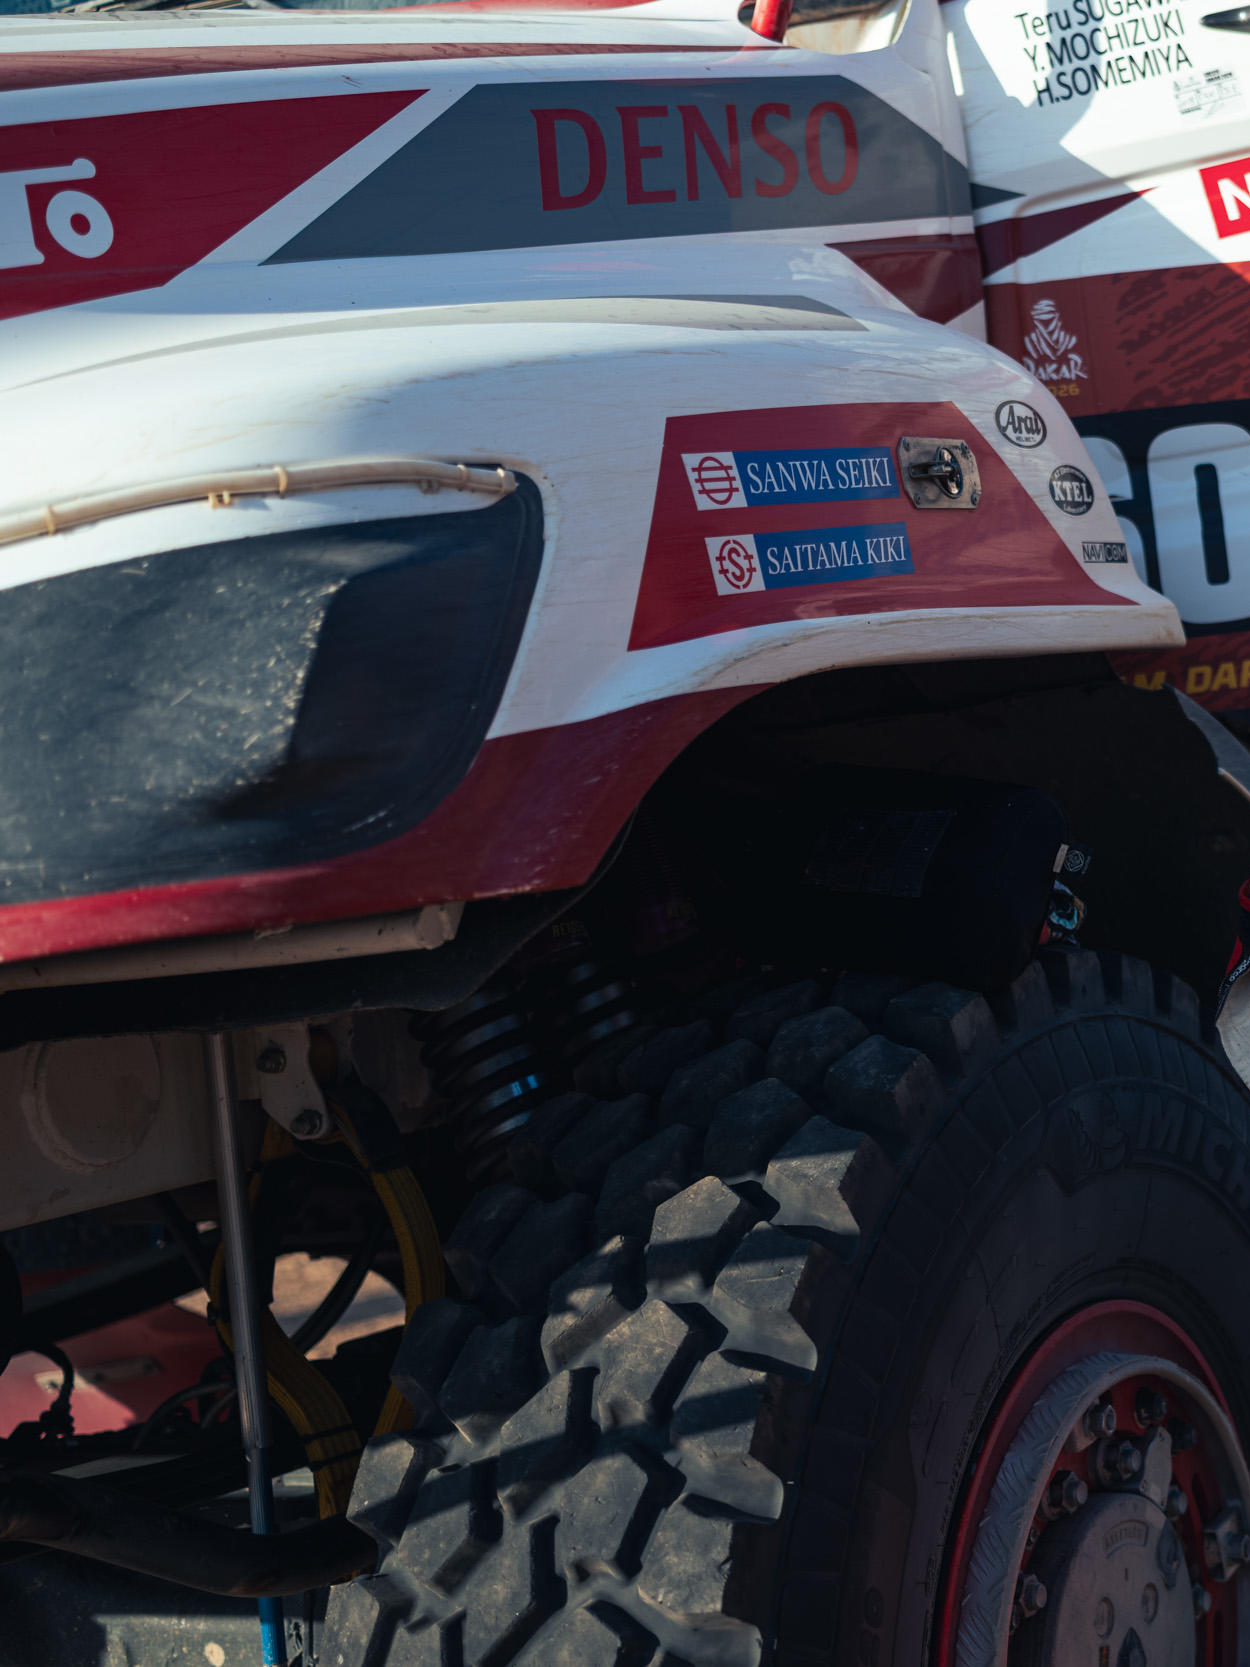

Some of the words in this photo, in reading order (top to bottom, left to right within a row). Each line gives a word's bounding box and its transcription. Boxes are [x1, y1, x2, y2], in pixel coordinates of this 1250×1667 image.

[1014, 9, 1072, 40] Teru
[1045, 8, 1185, 69] MOCHIZUKI
[1032, 43, 1193, 107] H.SOMEMIYA
[529, 101, 859, 212] DENSO
[1022, 353, 1088, 381] DAKAR
[1047, 383, 1080, 397] 026
[999, 405, 1042, 436] Arai
[746, 459, 834, 494] SANWA
[835, 457, 893, 489] SEIKI
[1052, 481, 1093, 503] KTEL
[766, 540, 863, 575] SAITAMA
[864, 536, 907, 564] KIKI
